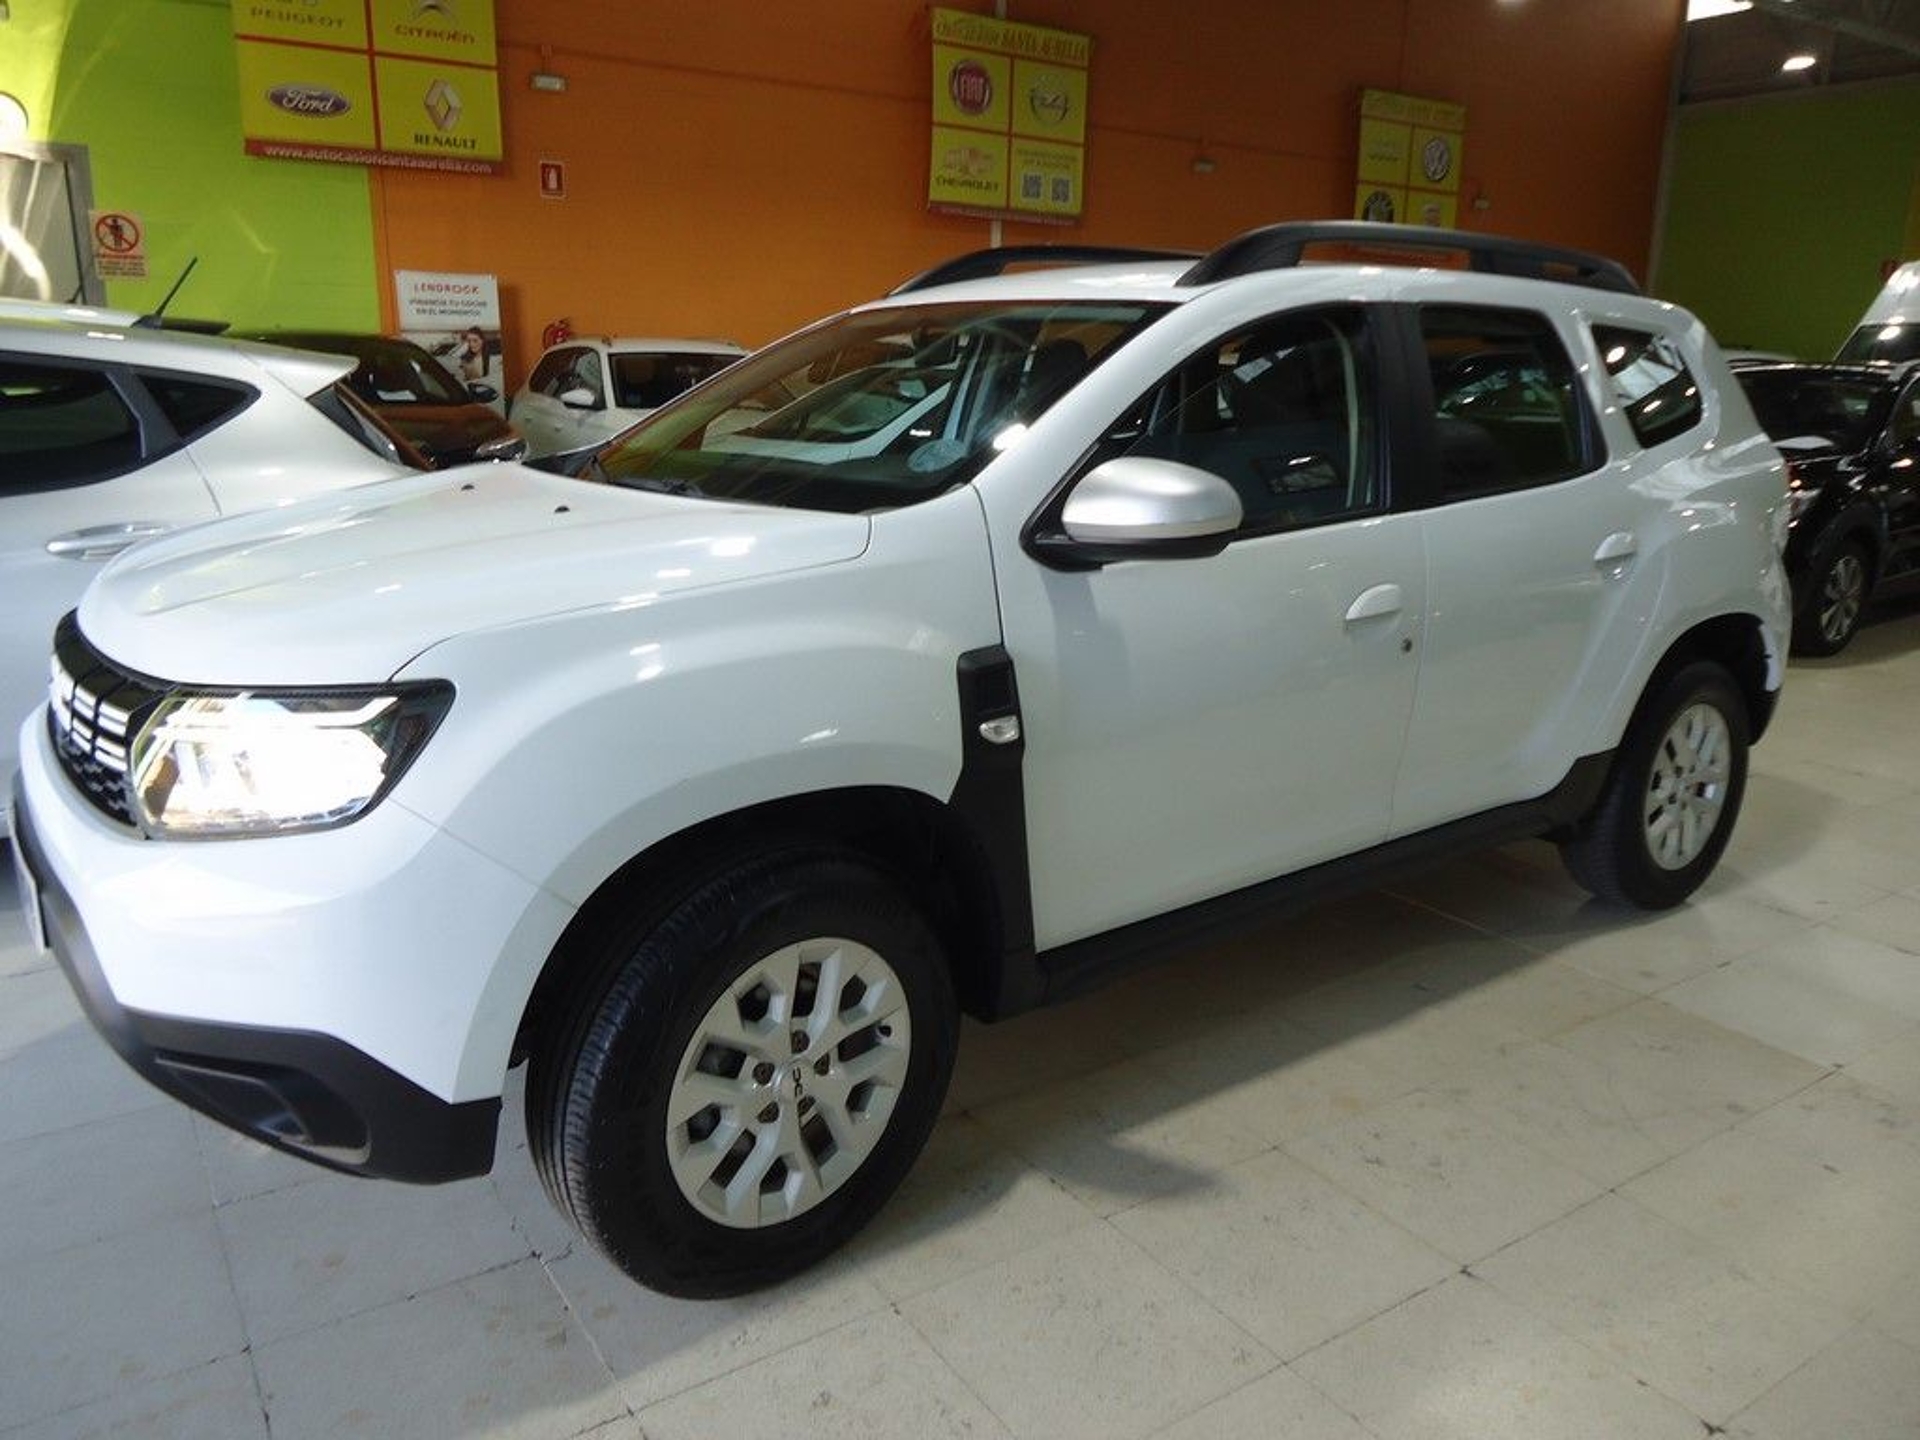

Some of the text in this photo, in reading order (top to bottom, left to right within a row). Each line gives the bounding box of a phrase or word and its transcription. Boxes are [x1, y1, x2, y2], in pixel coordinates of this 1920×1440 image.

[250, 7, 345, 28] PEUGEOT
[281, 86, 335, 113] Ford
[414, 133, 478, 151] RENAULT
[936, 174, 999, 192] CHEVROLET
